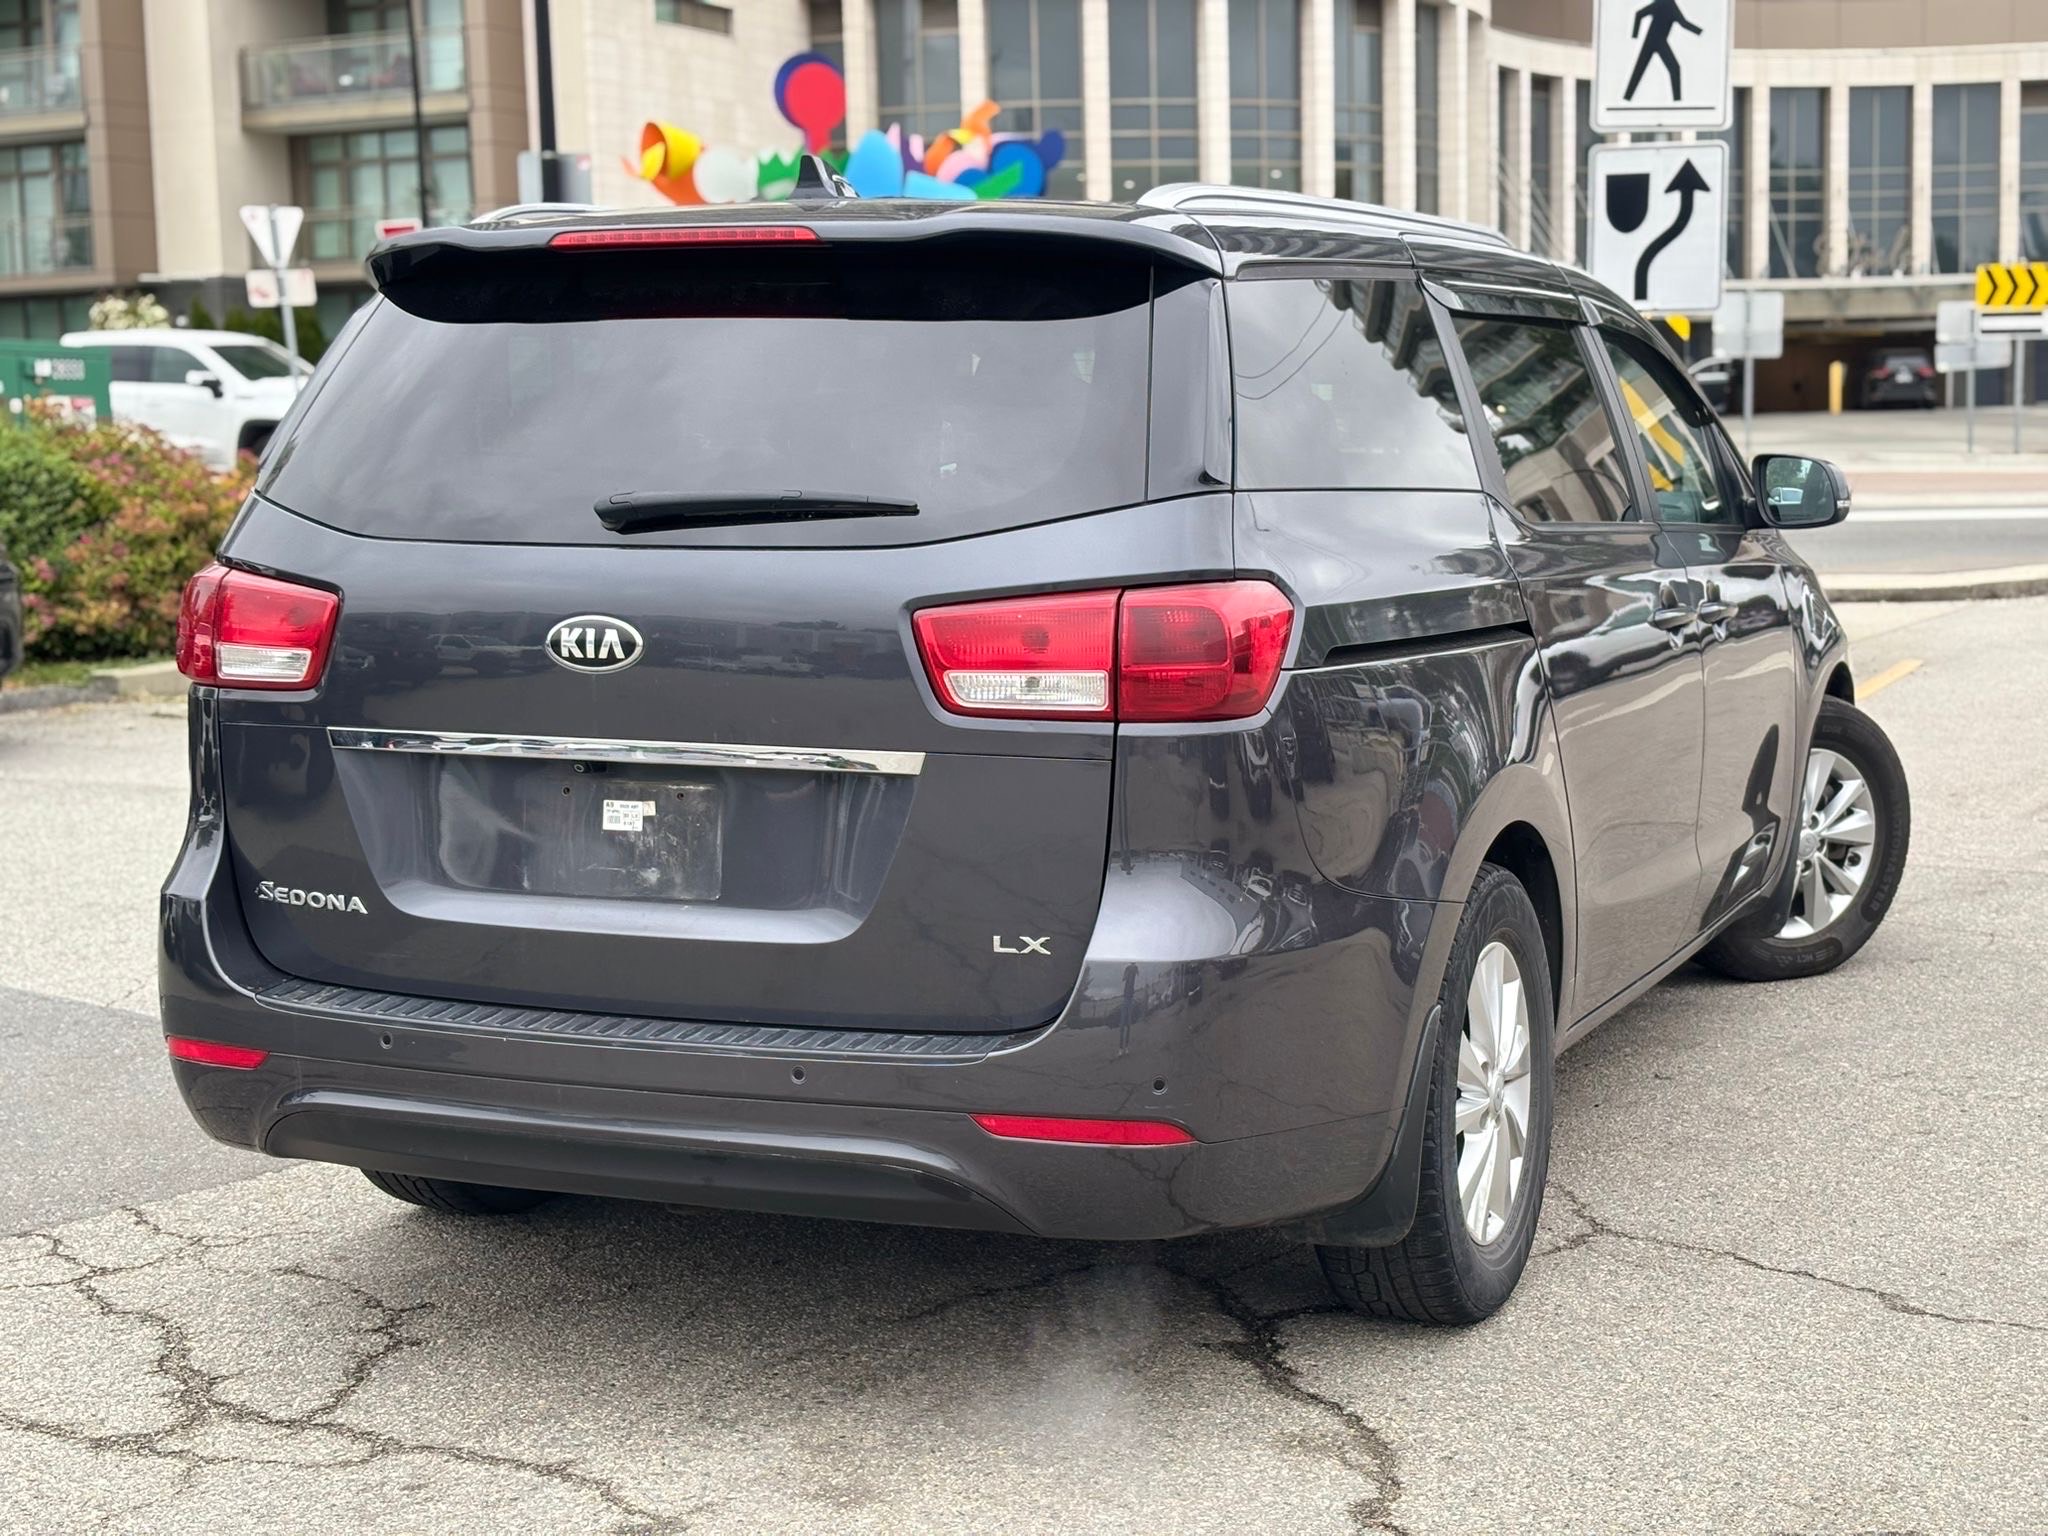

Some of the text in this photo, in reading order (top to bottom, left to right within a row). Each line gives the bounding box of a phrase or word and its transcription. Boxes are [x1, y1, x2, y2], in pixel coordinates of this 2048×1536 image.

[560, 627, 626, 660] KIA
[254, 880, 369, 915] SEDONA
[992, 935, 1052, 956] LX
